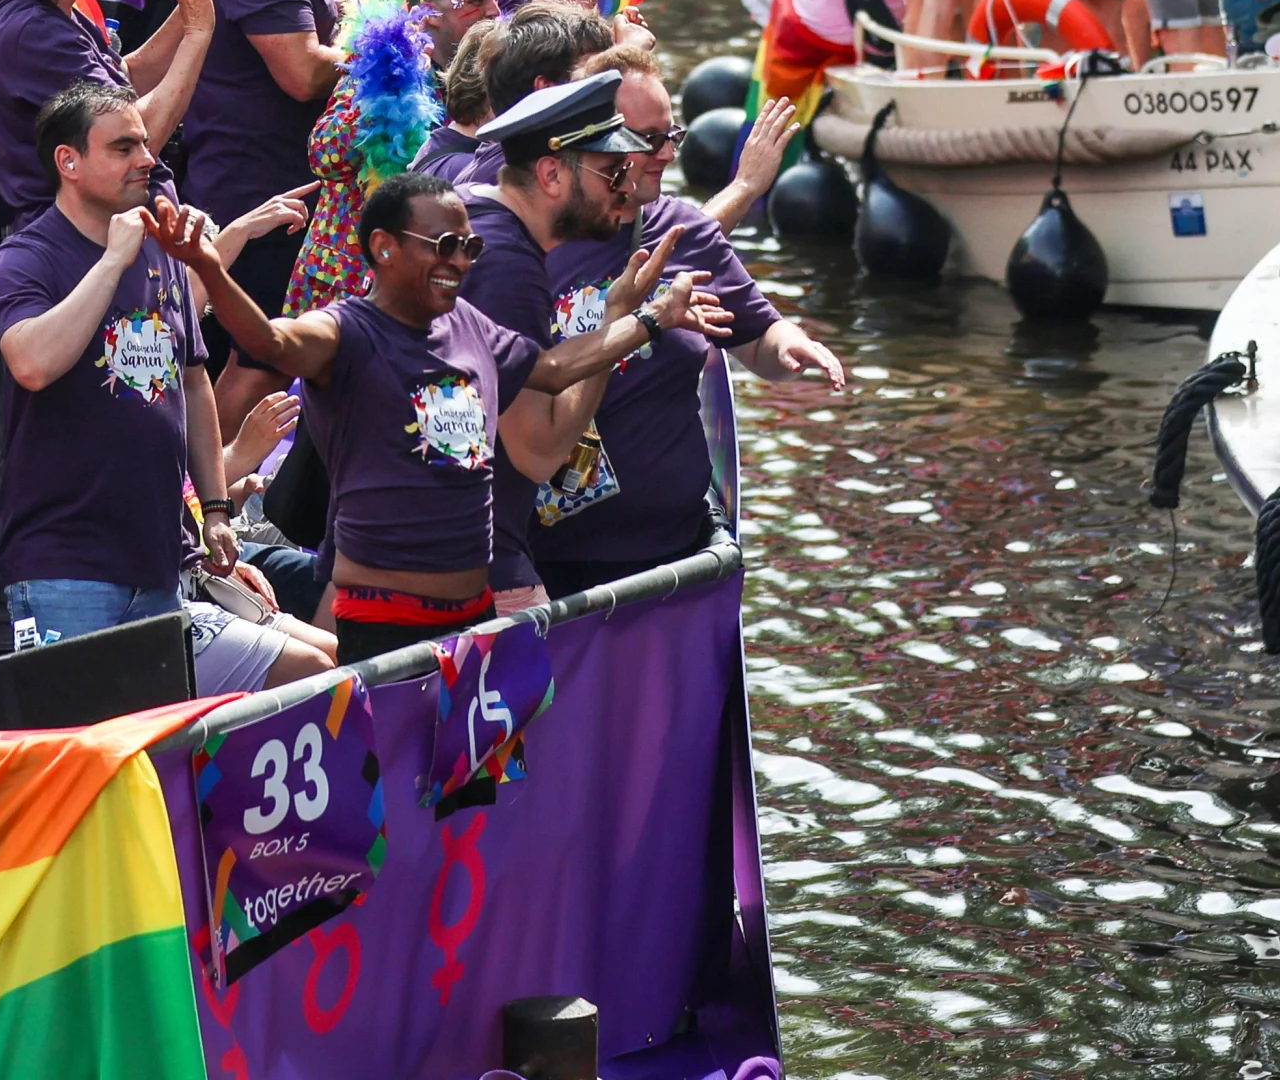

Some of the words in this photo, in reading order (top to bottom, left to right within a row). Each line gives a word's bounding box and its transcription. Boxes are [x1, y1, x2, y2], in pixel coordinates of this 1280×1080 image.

[1124, 87, 1259, 114] 03800597
[1170, 151, 1197, 173] 44
[1205, 149, 1254, 173] PAX
[120, 348, 166, 368] Samen
[433, 414, 479, 435] Samen
[243, 722, 330, 835] 33
[249, 834, 293, 860] BOX
[294, 832, 310, 852] 5
[243, 871, 363, 929] together
